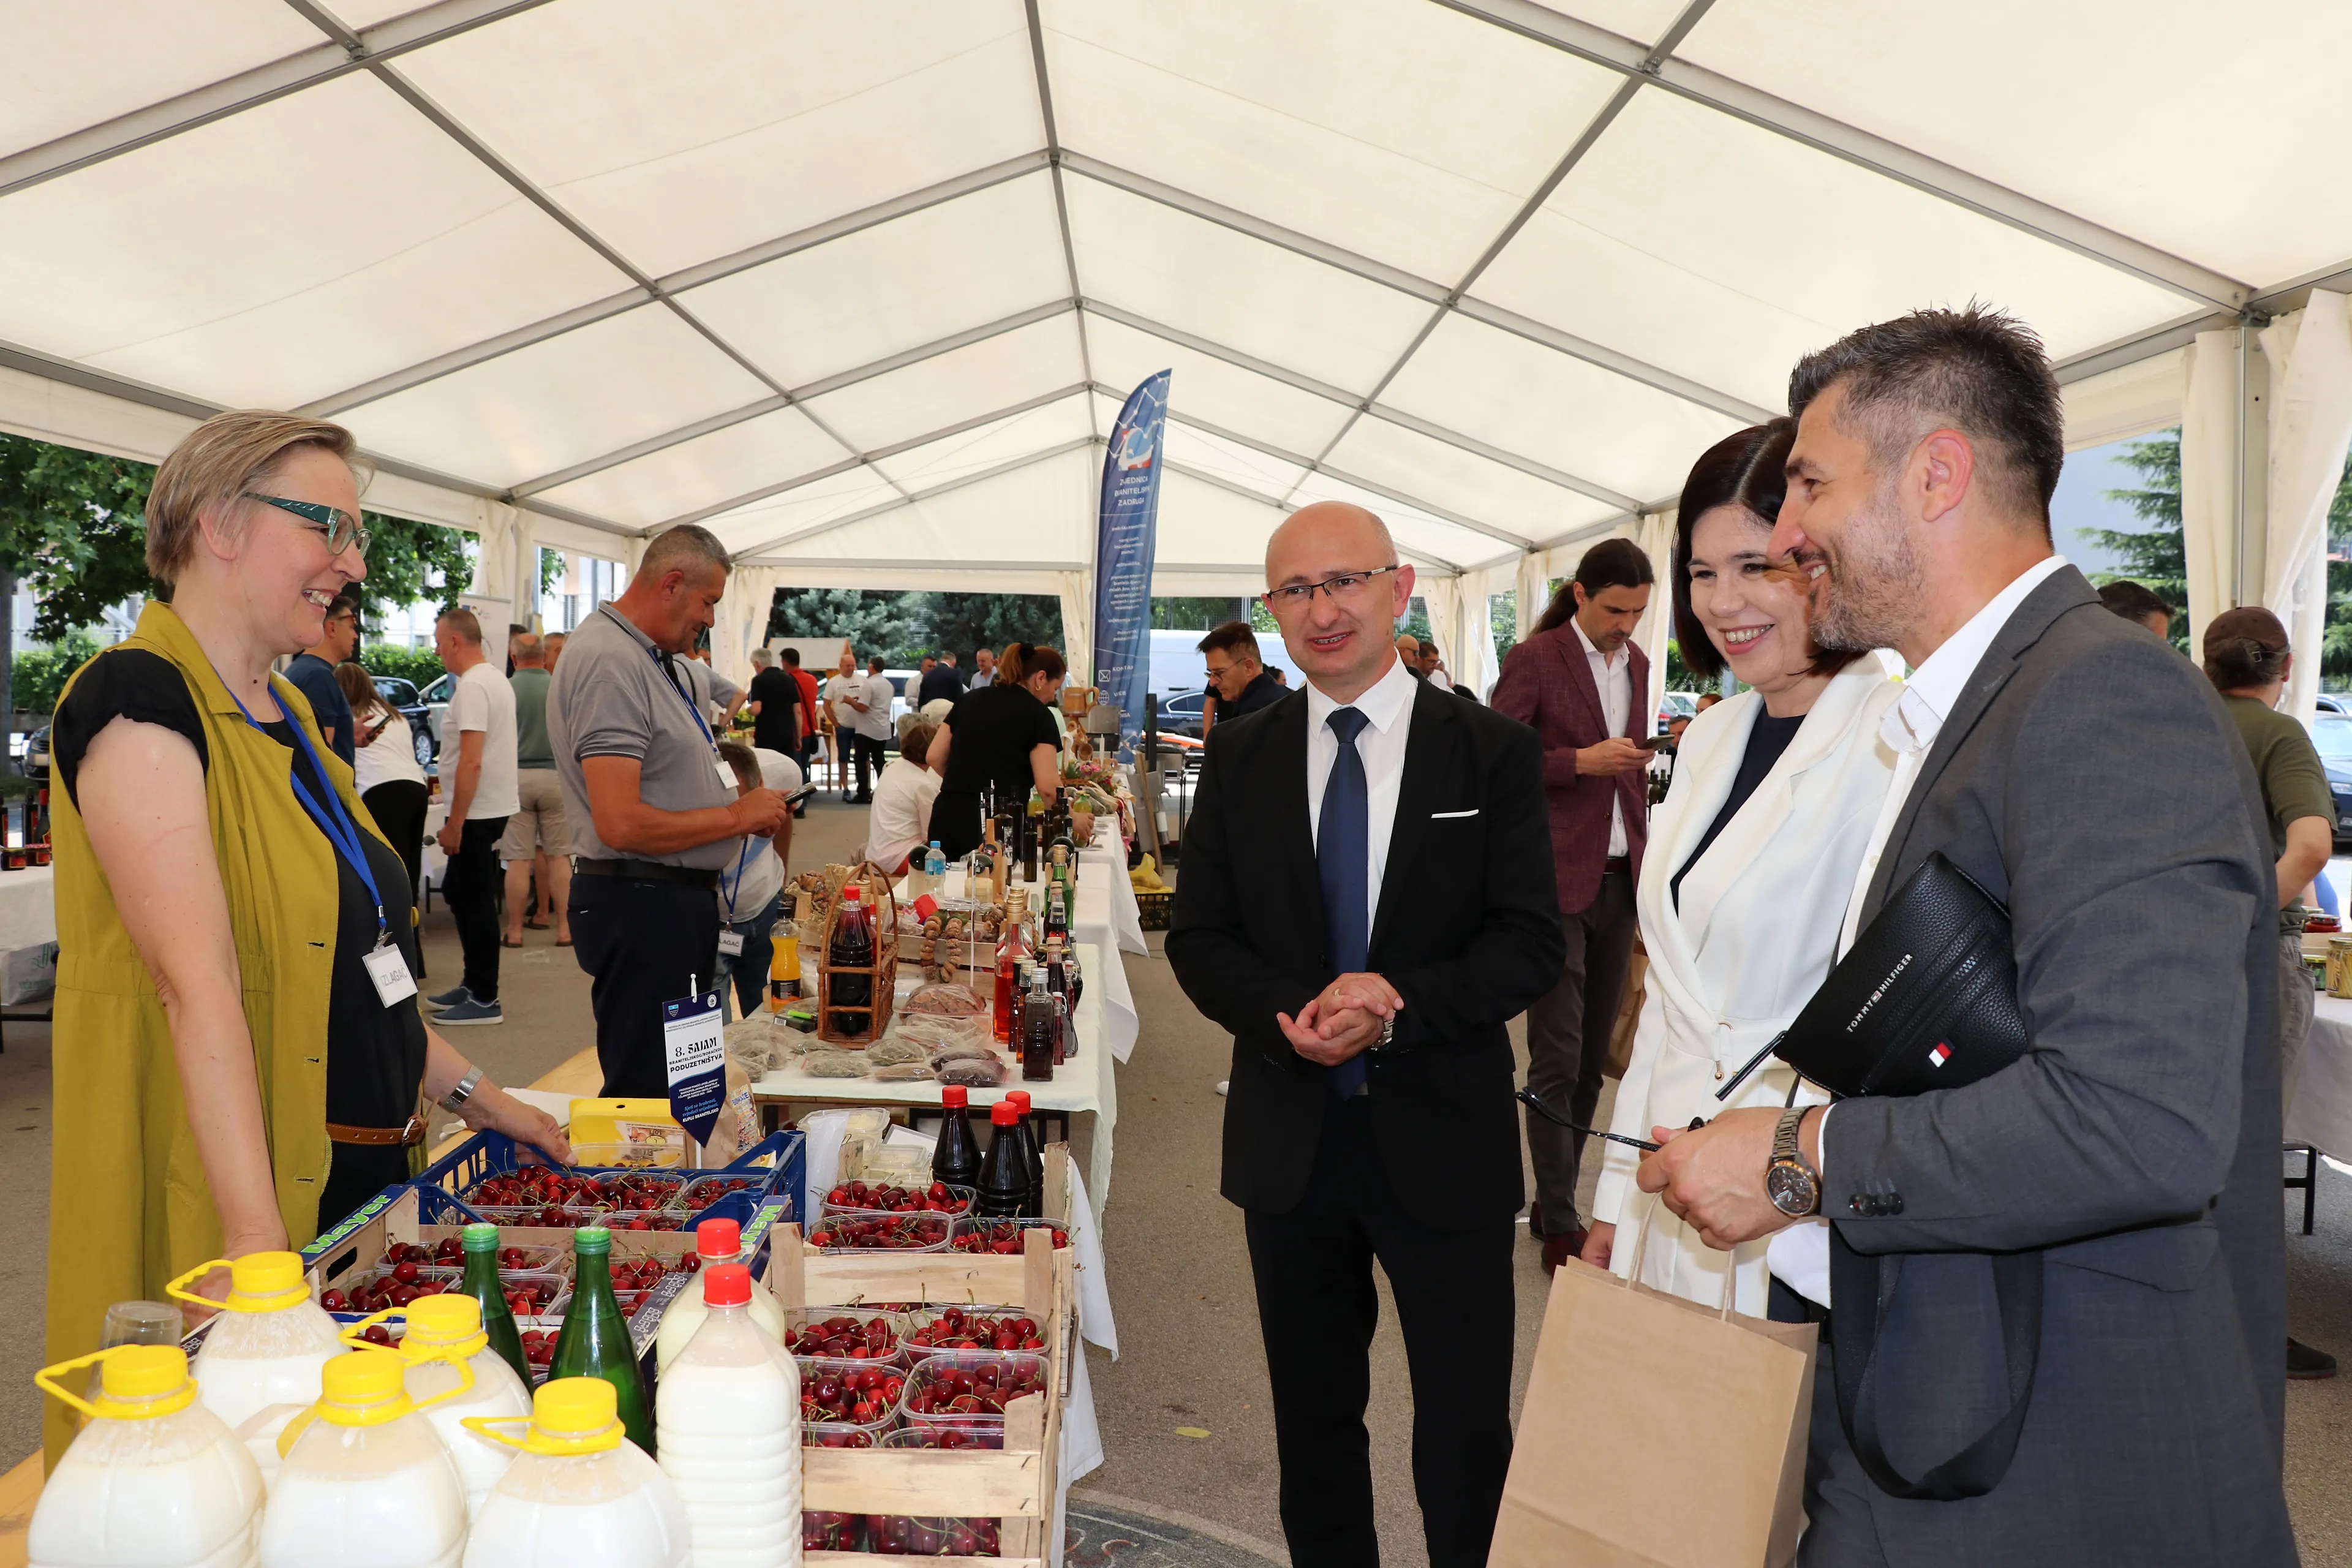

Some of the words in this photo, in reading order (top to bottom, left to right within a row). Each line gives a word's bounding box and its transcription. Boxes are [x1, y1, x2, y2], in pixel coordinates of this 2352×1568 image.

[1846, 1000, 1874, 1033] TOMMY
[1879, 953, 1913, 992] HILFIGER
[670, 1054, 722, 1072] PODUZETNIŠTVA
[675, 1046, 685, 1057] 8.
[688, 1036, 717, 1054] SAJAM
[300, 1194, 392, 1254] Mayer
